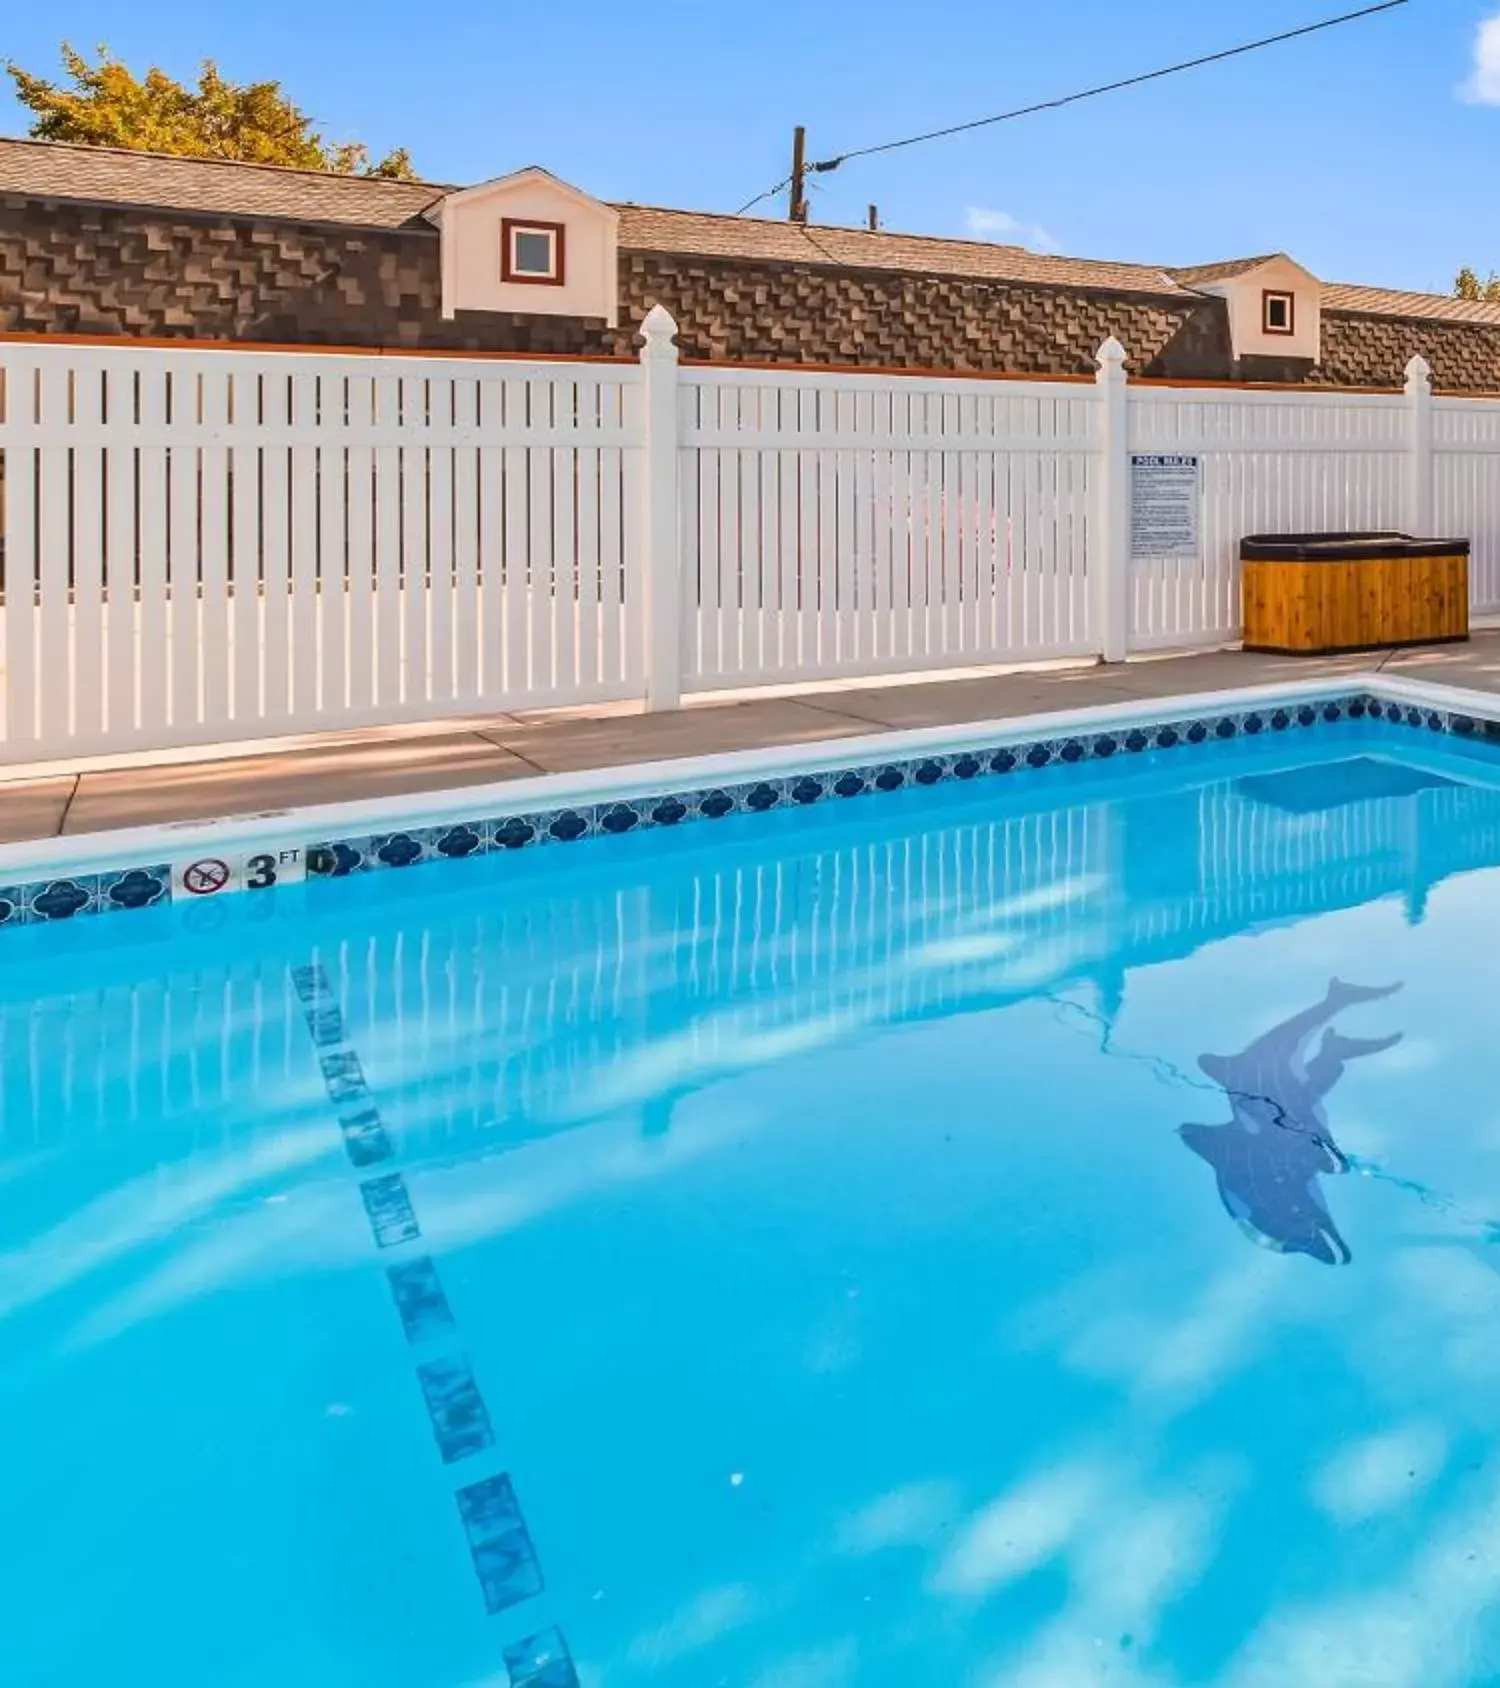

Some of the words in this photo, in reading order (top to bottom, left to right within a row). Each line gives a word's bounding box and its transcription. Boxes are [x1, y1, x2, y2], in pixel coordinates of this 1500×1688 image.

[1136, 456, 1159, 465] POOL
[1163, 457, 1192, 465] RULES
[247, 854, 277, 889] 3
[279, 849, 300, 864] FT
